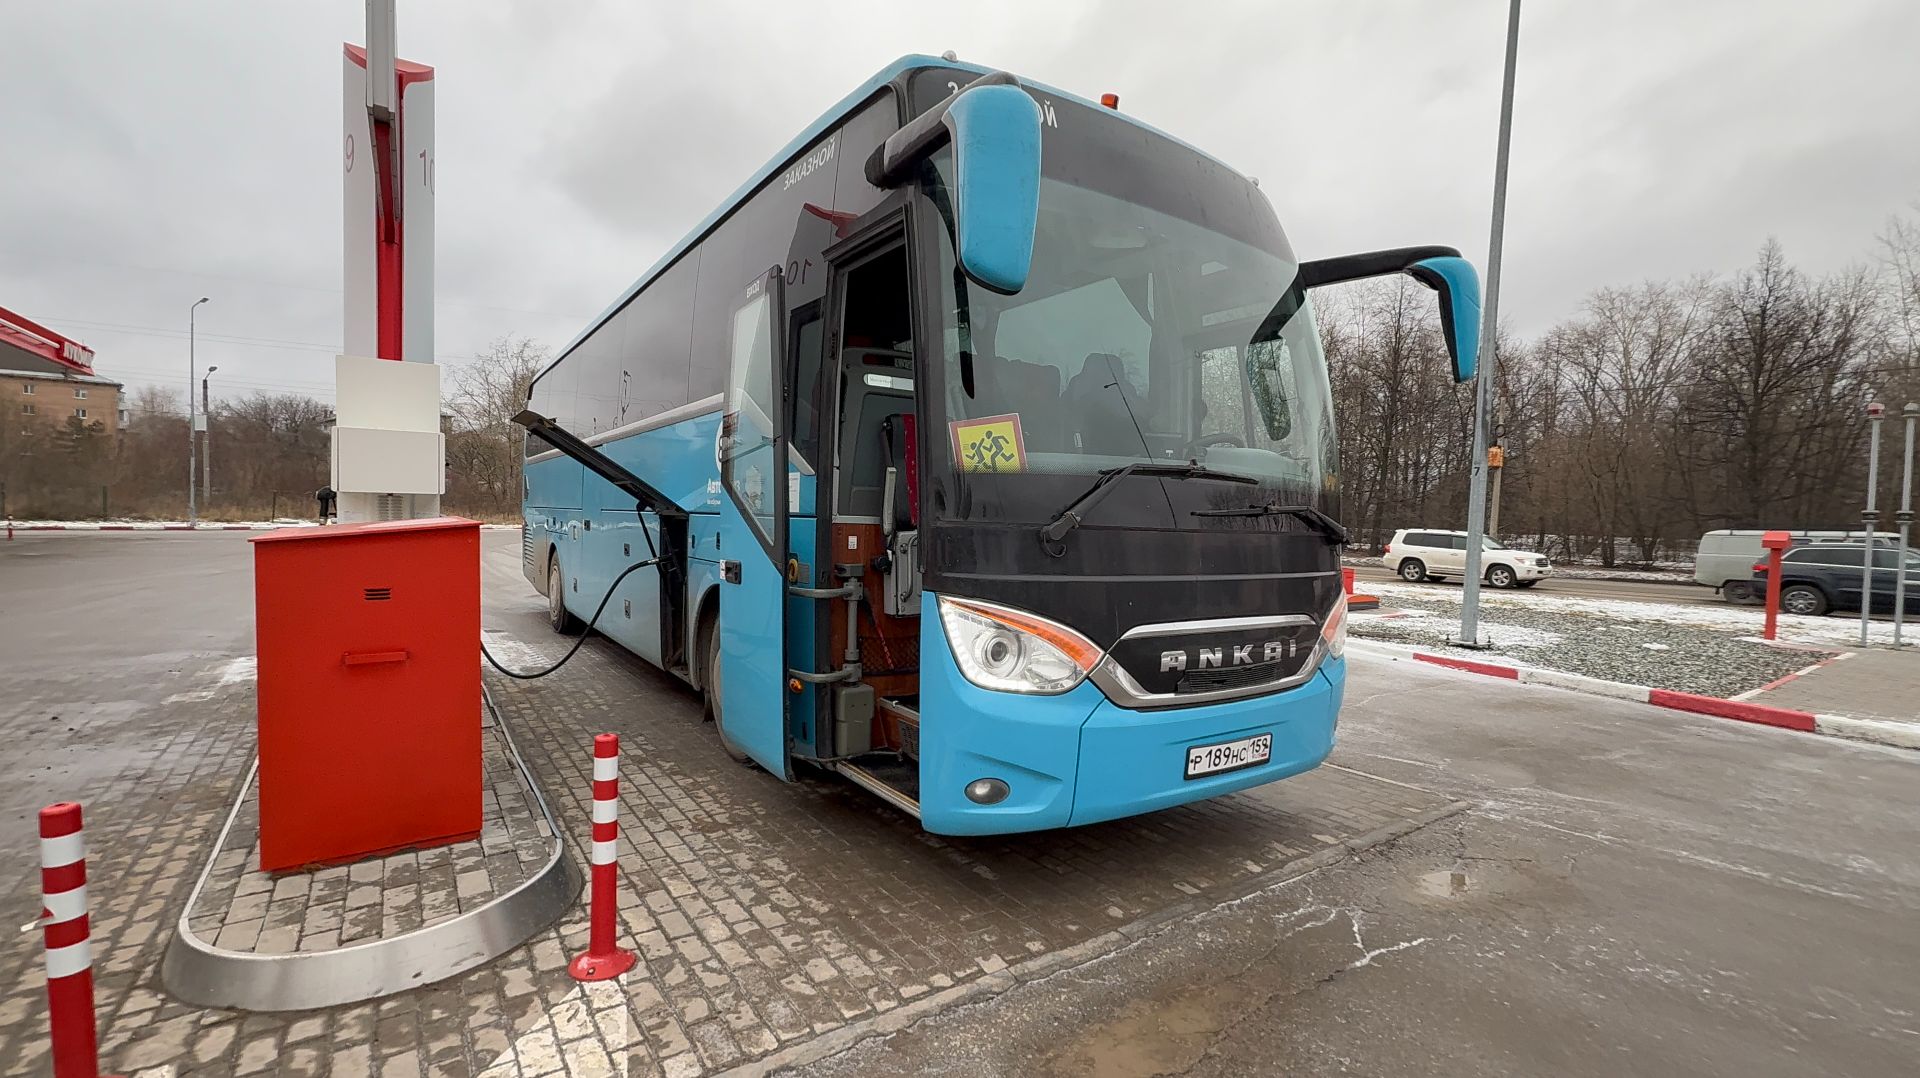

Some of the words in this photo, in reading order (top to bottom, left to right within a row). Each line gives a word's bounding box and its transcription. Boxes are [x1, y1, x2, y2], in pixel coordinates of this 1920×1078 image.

[345, 134, 355, 173] 9
[783, 136, 836, 191] ЗАКАЗНОЙ
[1474, 467, 1480, 476] 7
[1160, 639, 1297, 673] ANKAI
[1250, 737, 1268, 754] 159
